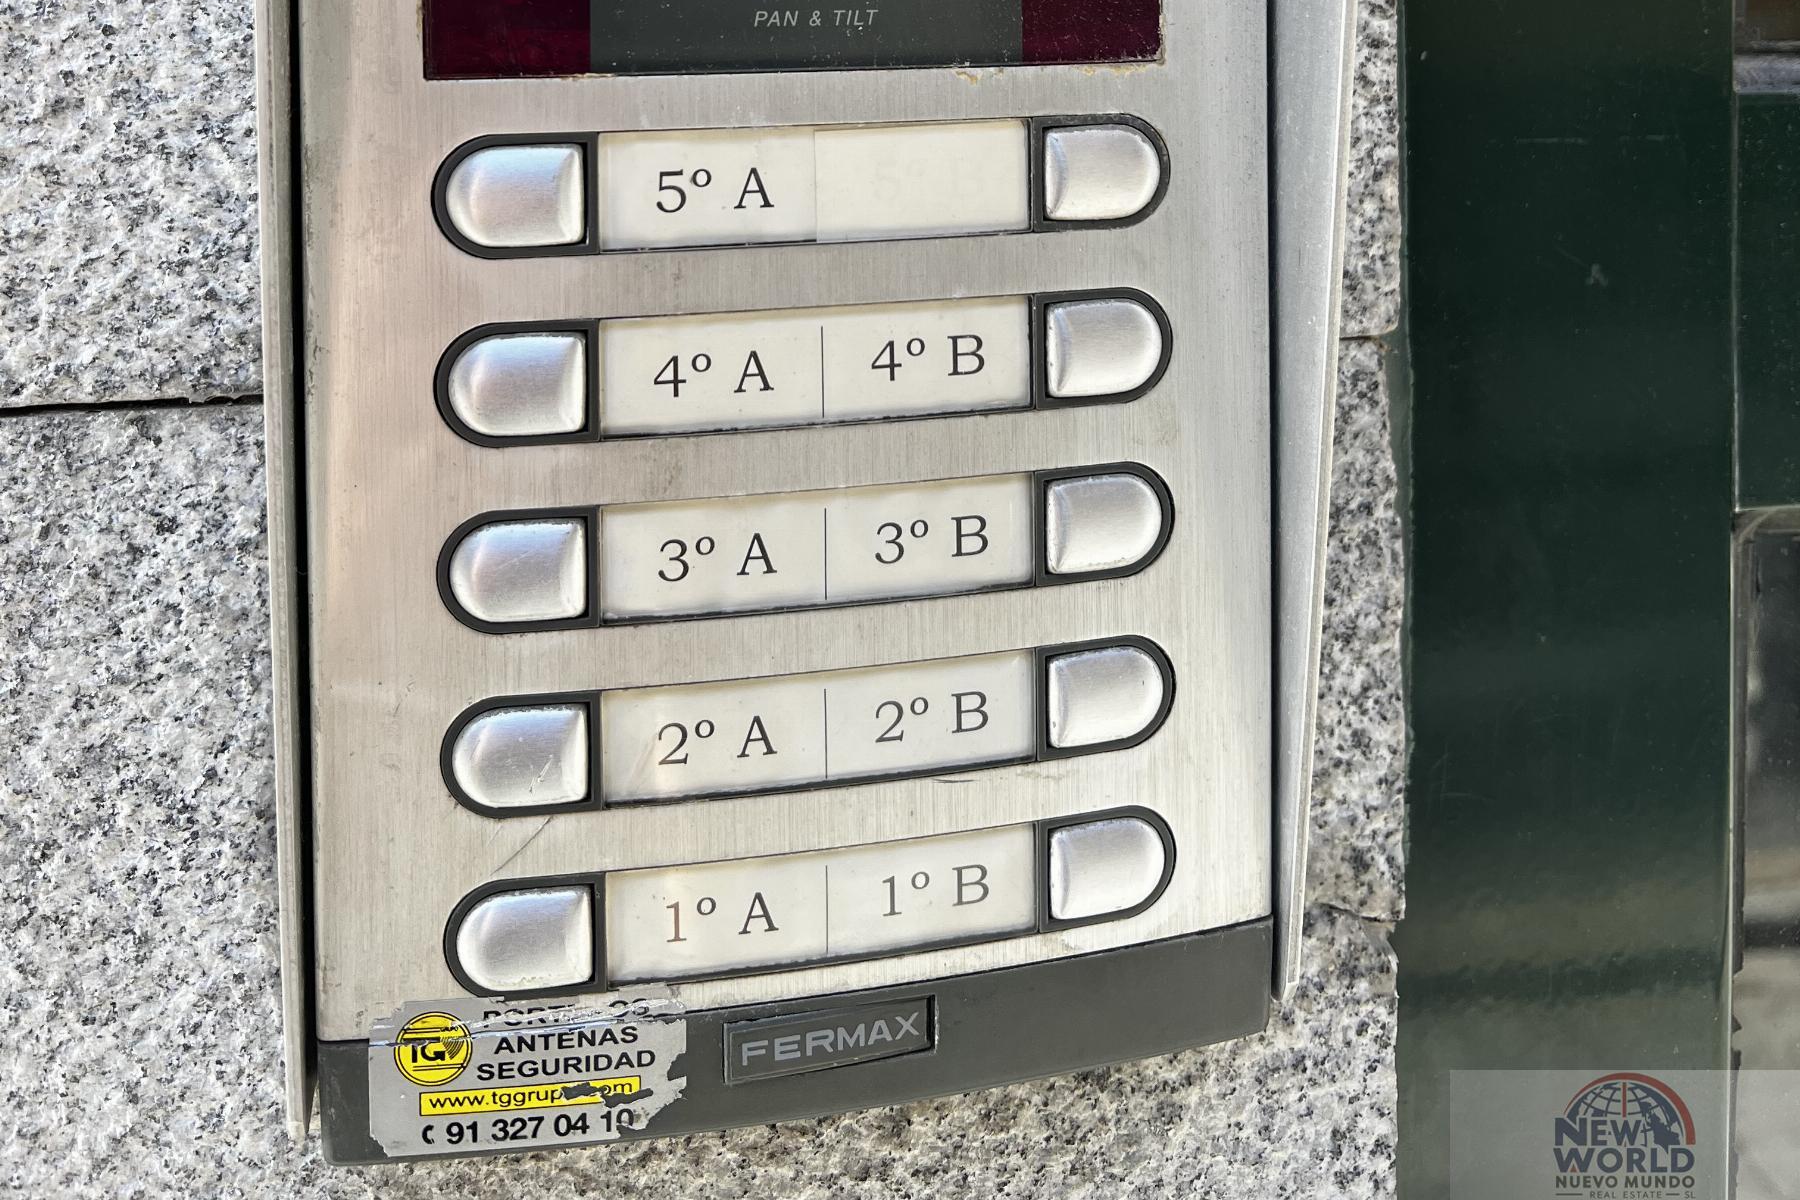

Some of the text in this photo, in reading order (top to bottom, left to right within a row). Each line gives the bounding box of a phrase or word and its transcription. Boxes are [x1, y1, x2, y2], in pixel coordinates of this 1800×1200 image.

[754, 9, 879, 27] PAN & TILT
[734, 167, 775, 210] A
[734, 350, 775, 393] A
[947, 334, 985, 376] B
[736, 532, 778, 576] A
[951, 514, 989, 558] B
[951, 691, 989, 734] B
[736, 715, 778, 758] A
[952, 864, 990, 907] B
[738, 892, 779, 935] A
[494, 1025, 639, 1055] ANTENAS
[740, 1012, 920, 1067] FERMAX
[476, 1050, 656, 1081] SEGURIDAD
[446, 1108, 634, 1145] 91 327 04 10
